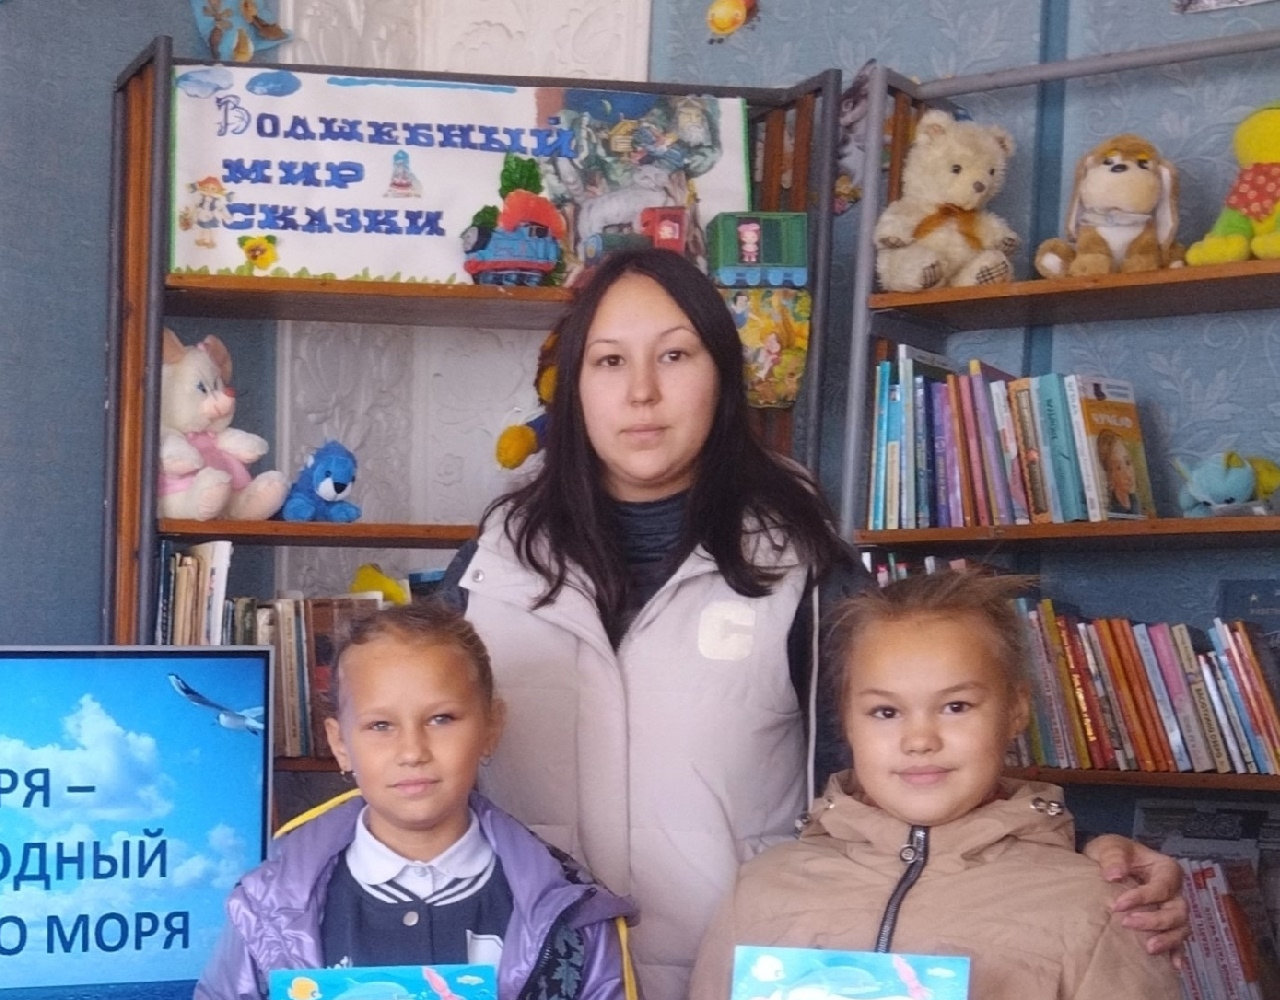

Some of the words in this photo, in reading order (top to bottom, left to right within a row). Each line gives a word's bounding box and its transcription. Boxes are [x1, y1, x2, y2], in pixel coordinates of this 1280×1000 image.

[222, 158, 364, 189] МИР
[222, 203, 446, 237] СКАЗКИ
[47, 911, 191, 955] МОРЯ
